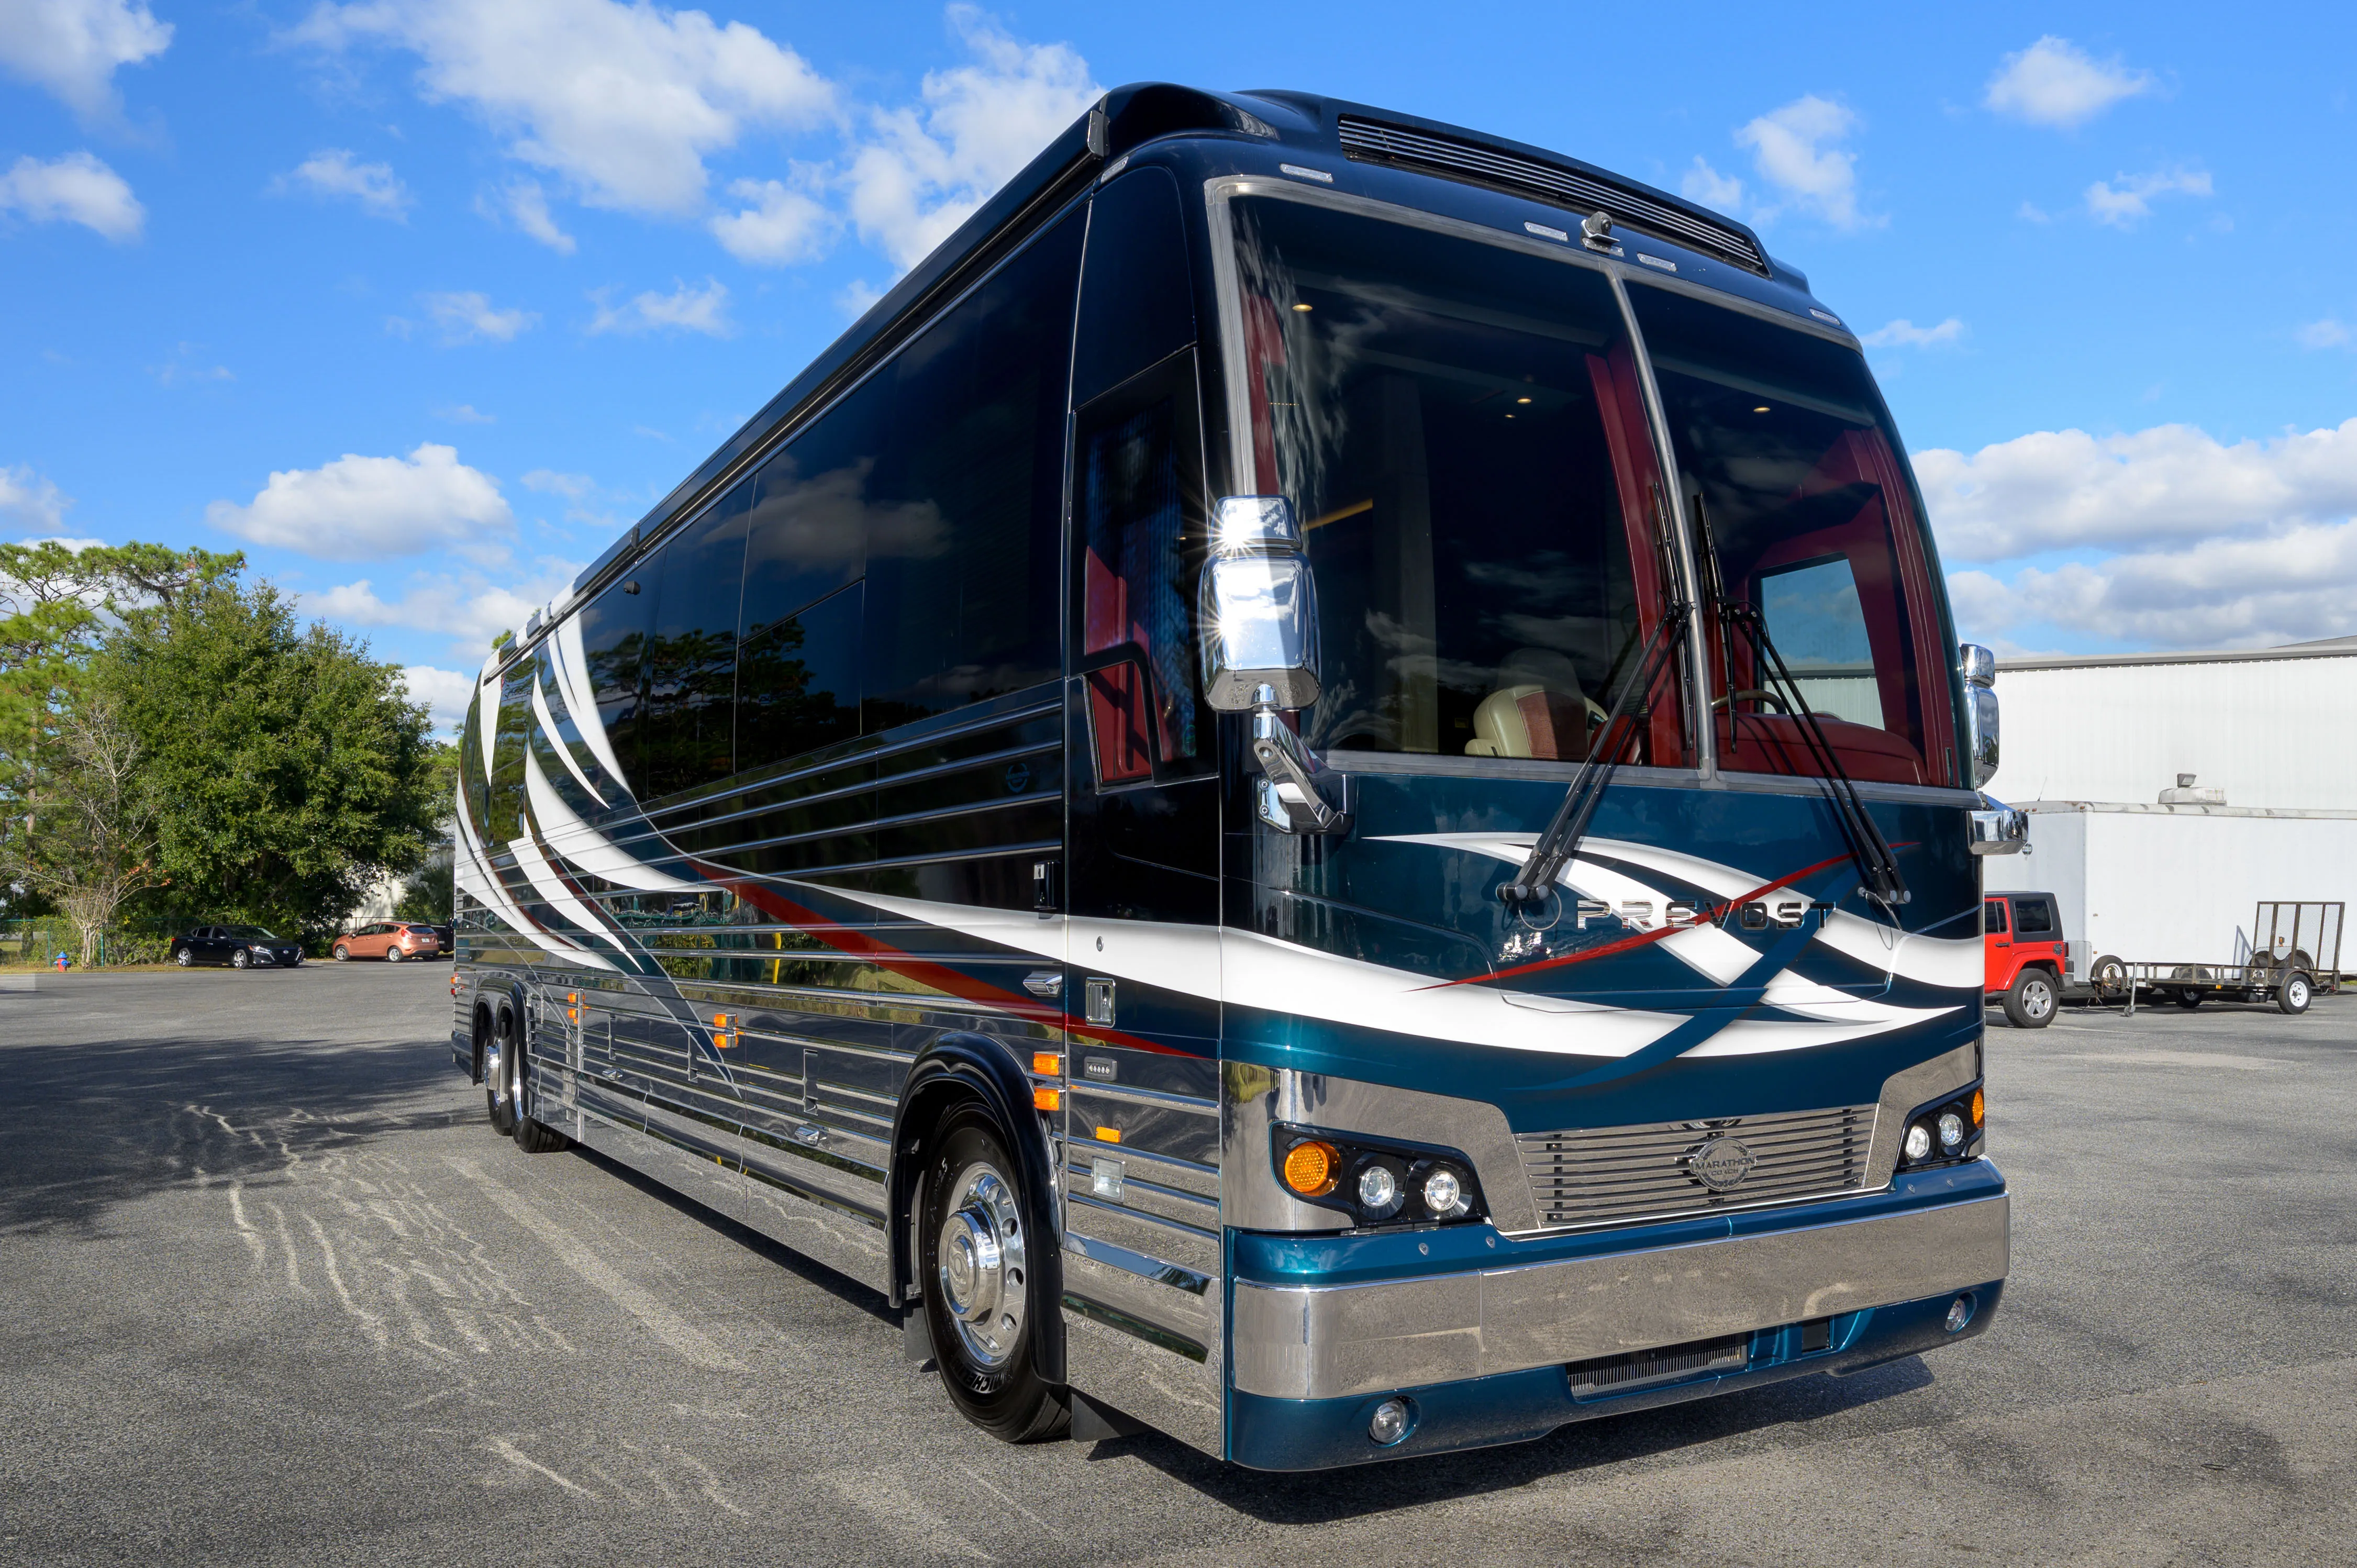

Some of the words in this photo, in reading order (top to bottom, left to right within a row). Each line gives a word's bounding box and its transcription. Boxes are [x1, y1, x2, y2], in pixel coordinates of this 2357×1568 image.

[1576, 898, 1837, 930] PREVOST
[1695, 1158, 1754, 1170] MARATHON
[950, 1357, 1005, 1392] MICHELIN
